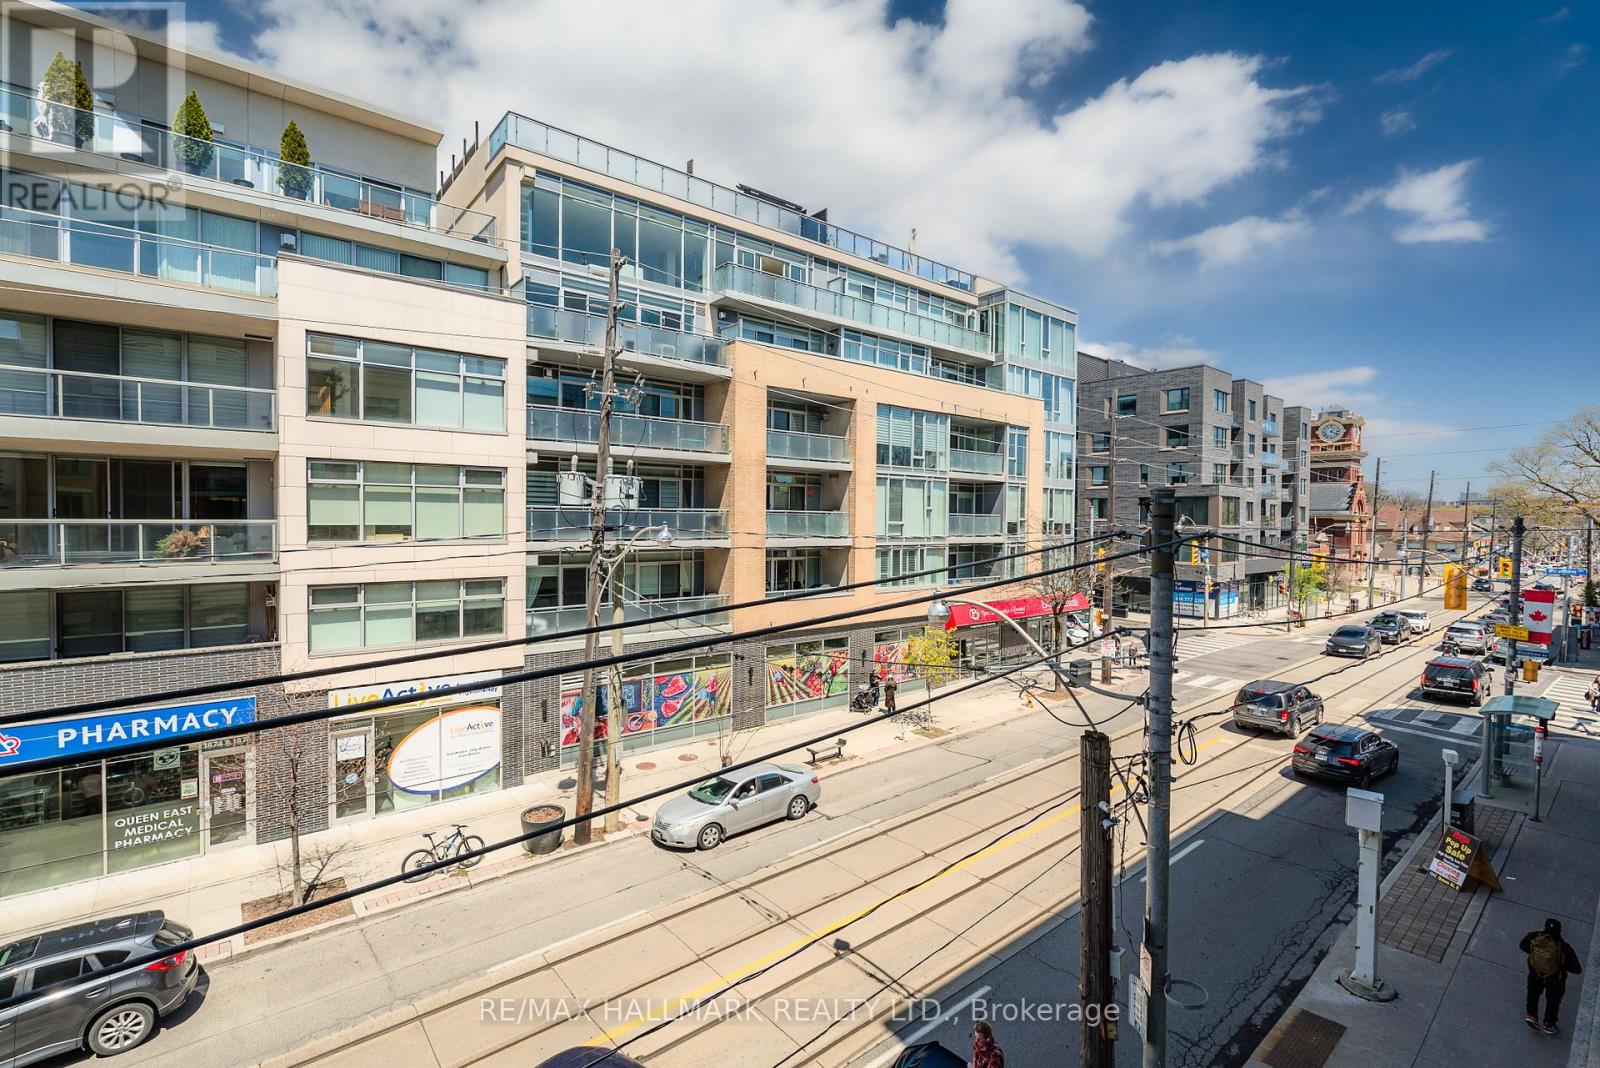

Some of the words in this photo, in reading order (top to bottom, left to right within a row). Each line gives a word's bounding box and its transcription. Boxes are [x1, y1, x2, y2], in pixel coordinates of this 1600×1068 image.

[333, 681, 451, 710] LiveActi
[57, 706, 238, 749] PHARMACY
[114, 812, 159, 828] QUEEN
[163, 805, 193, 818] EAST
[115, 826, 193, 849] PHARMACY
[124, 818, 184, 838] MEDICAL
[1445, 837, 1460, 849] Pop
[1461, 844, 1472, 855] Up
[1445, 845, 1466, 861] Sale
[1437, 861, 1461, 878] Closing
